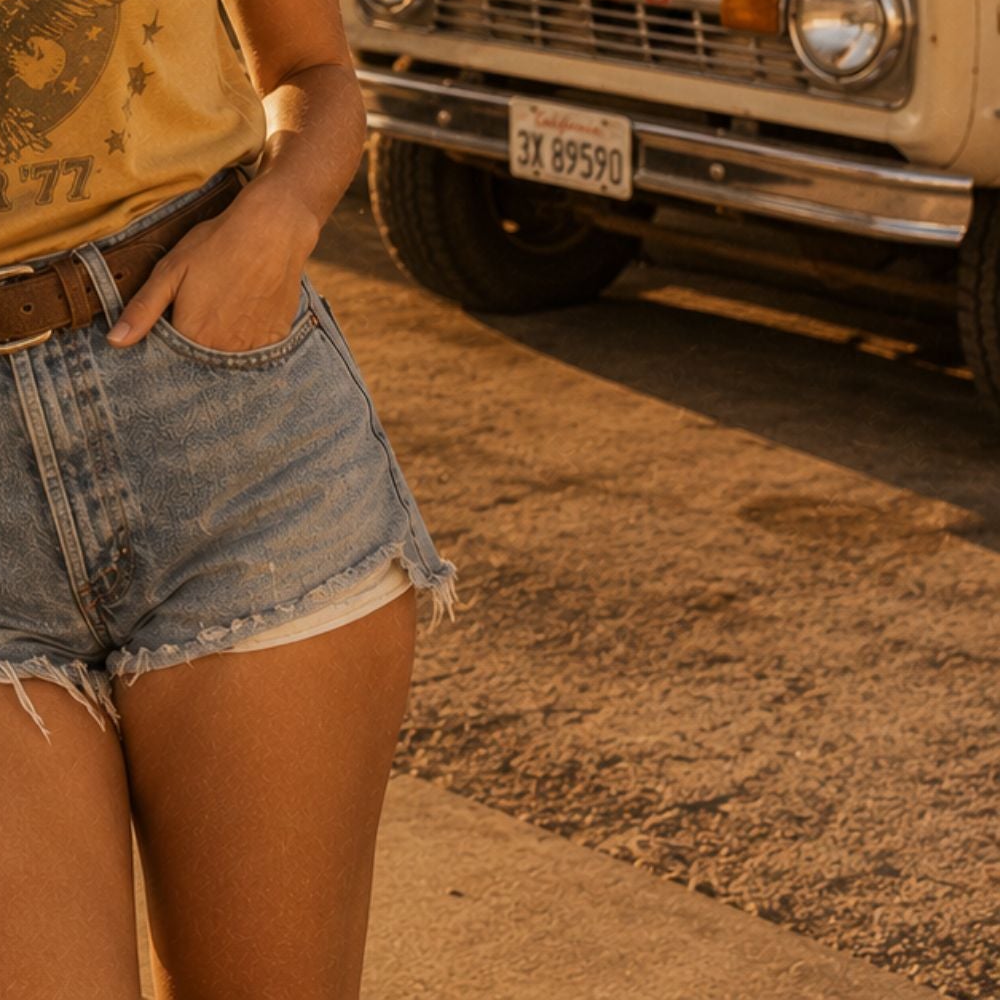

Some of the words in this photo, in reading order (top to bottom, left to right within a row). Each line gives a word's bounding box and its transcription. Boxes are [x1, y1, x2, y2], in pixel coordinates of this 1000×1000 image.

[18, 154, 95, 206] '77
[517, 130, 545, 169] 3X
[551, 137, 623, 185] 89590
